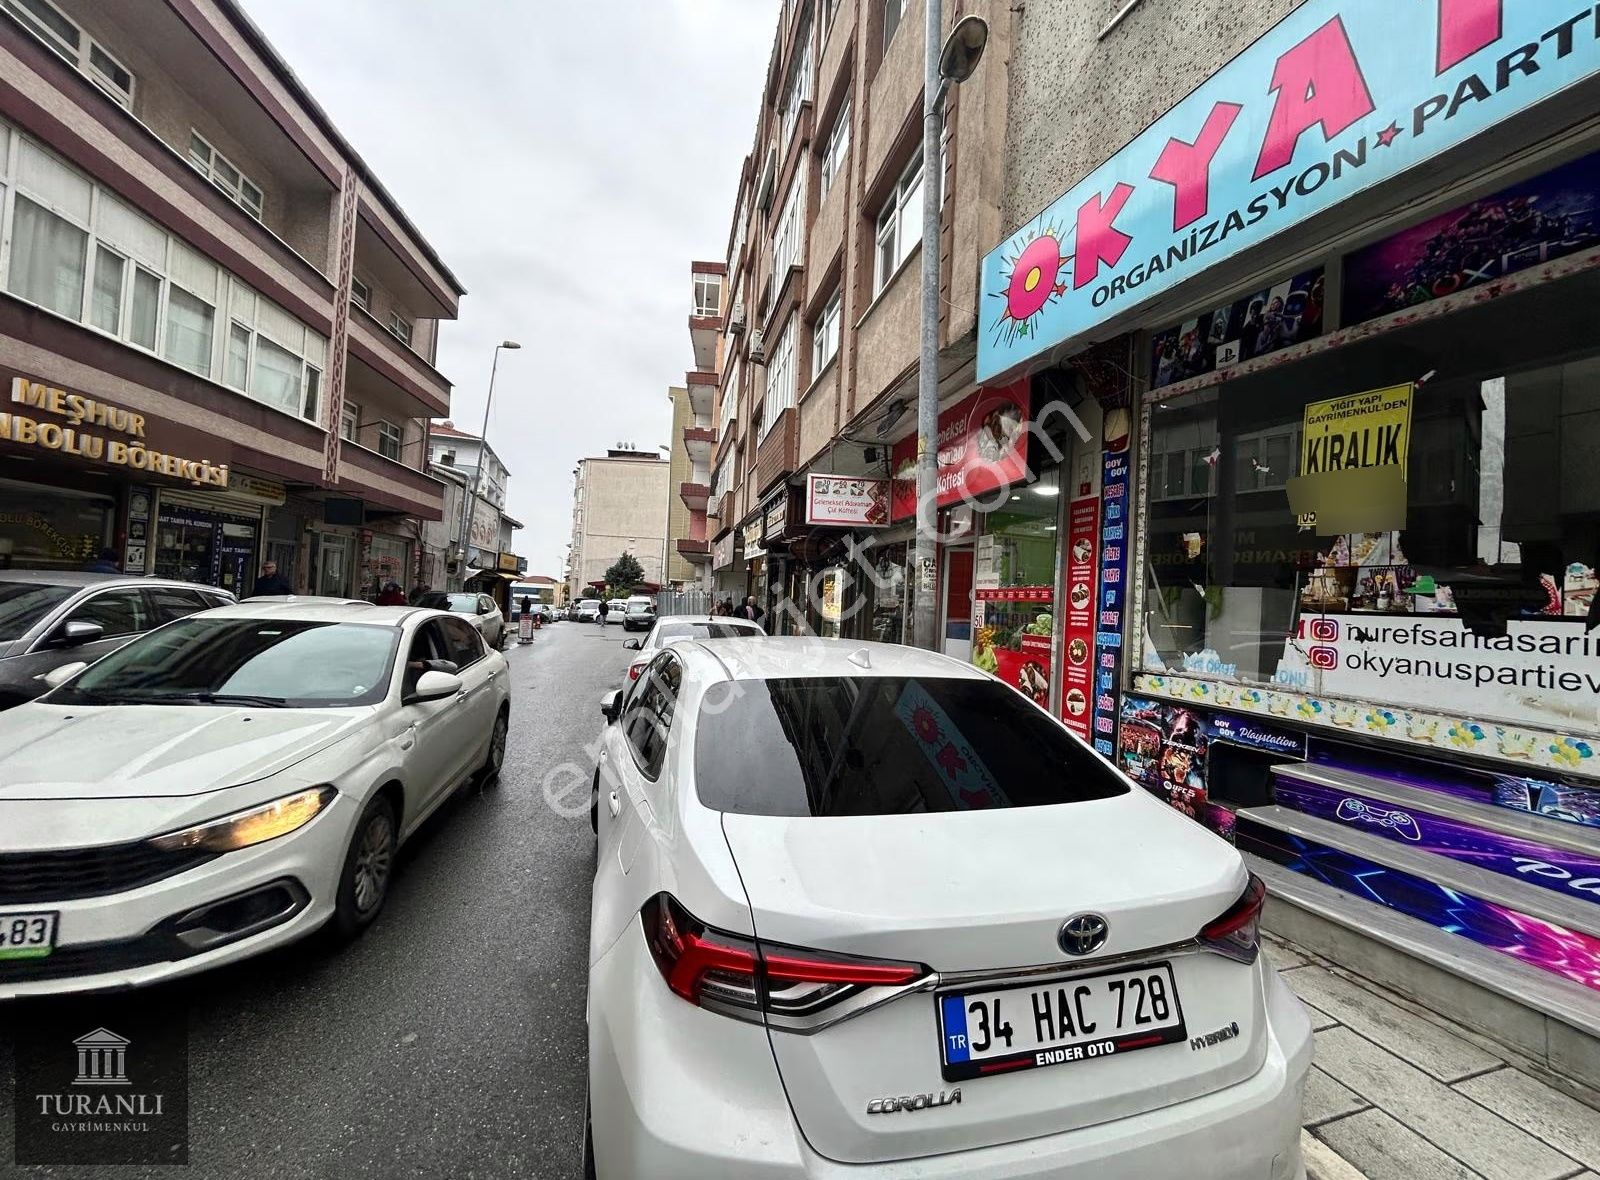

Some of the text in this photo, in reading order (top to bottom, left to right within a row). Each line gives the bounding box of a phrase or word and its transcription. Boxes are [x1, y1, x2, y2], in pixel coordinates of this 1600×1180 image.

[1006, 0, 1501, 321] OKYA
[1091, 3, 1600, 308] ORGANİZASYON PART
[11, 377, 146, 437] MEŞHUR
[1308, 399, 1408, 424] GAYRİMENKUL'DEN
[1358, 394, 1382, 405] YAPI
[107, 441, 229, 487] BÖREKÇİSİ
[1306, 423, 1402, 474] KİRALIK
[936, 467, 965, 493] Köftesi
[1239, 727, 1299, 748] Playstation
[949, 975, 1170, 1052] TR 34 HAC 728
[1036, 1041, 1115, 1067] ENDER OTO
[866, 1087, 963, 1114] COROLLA
